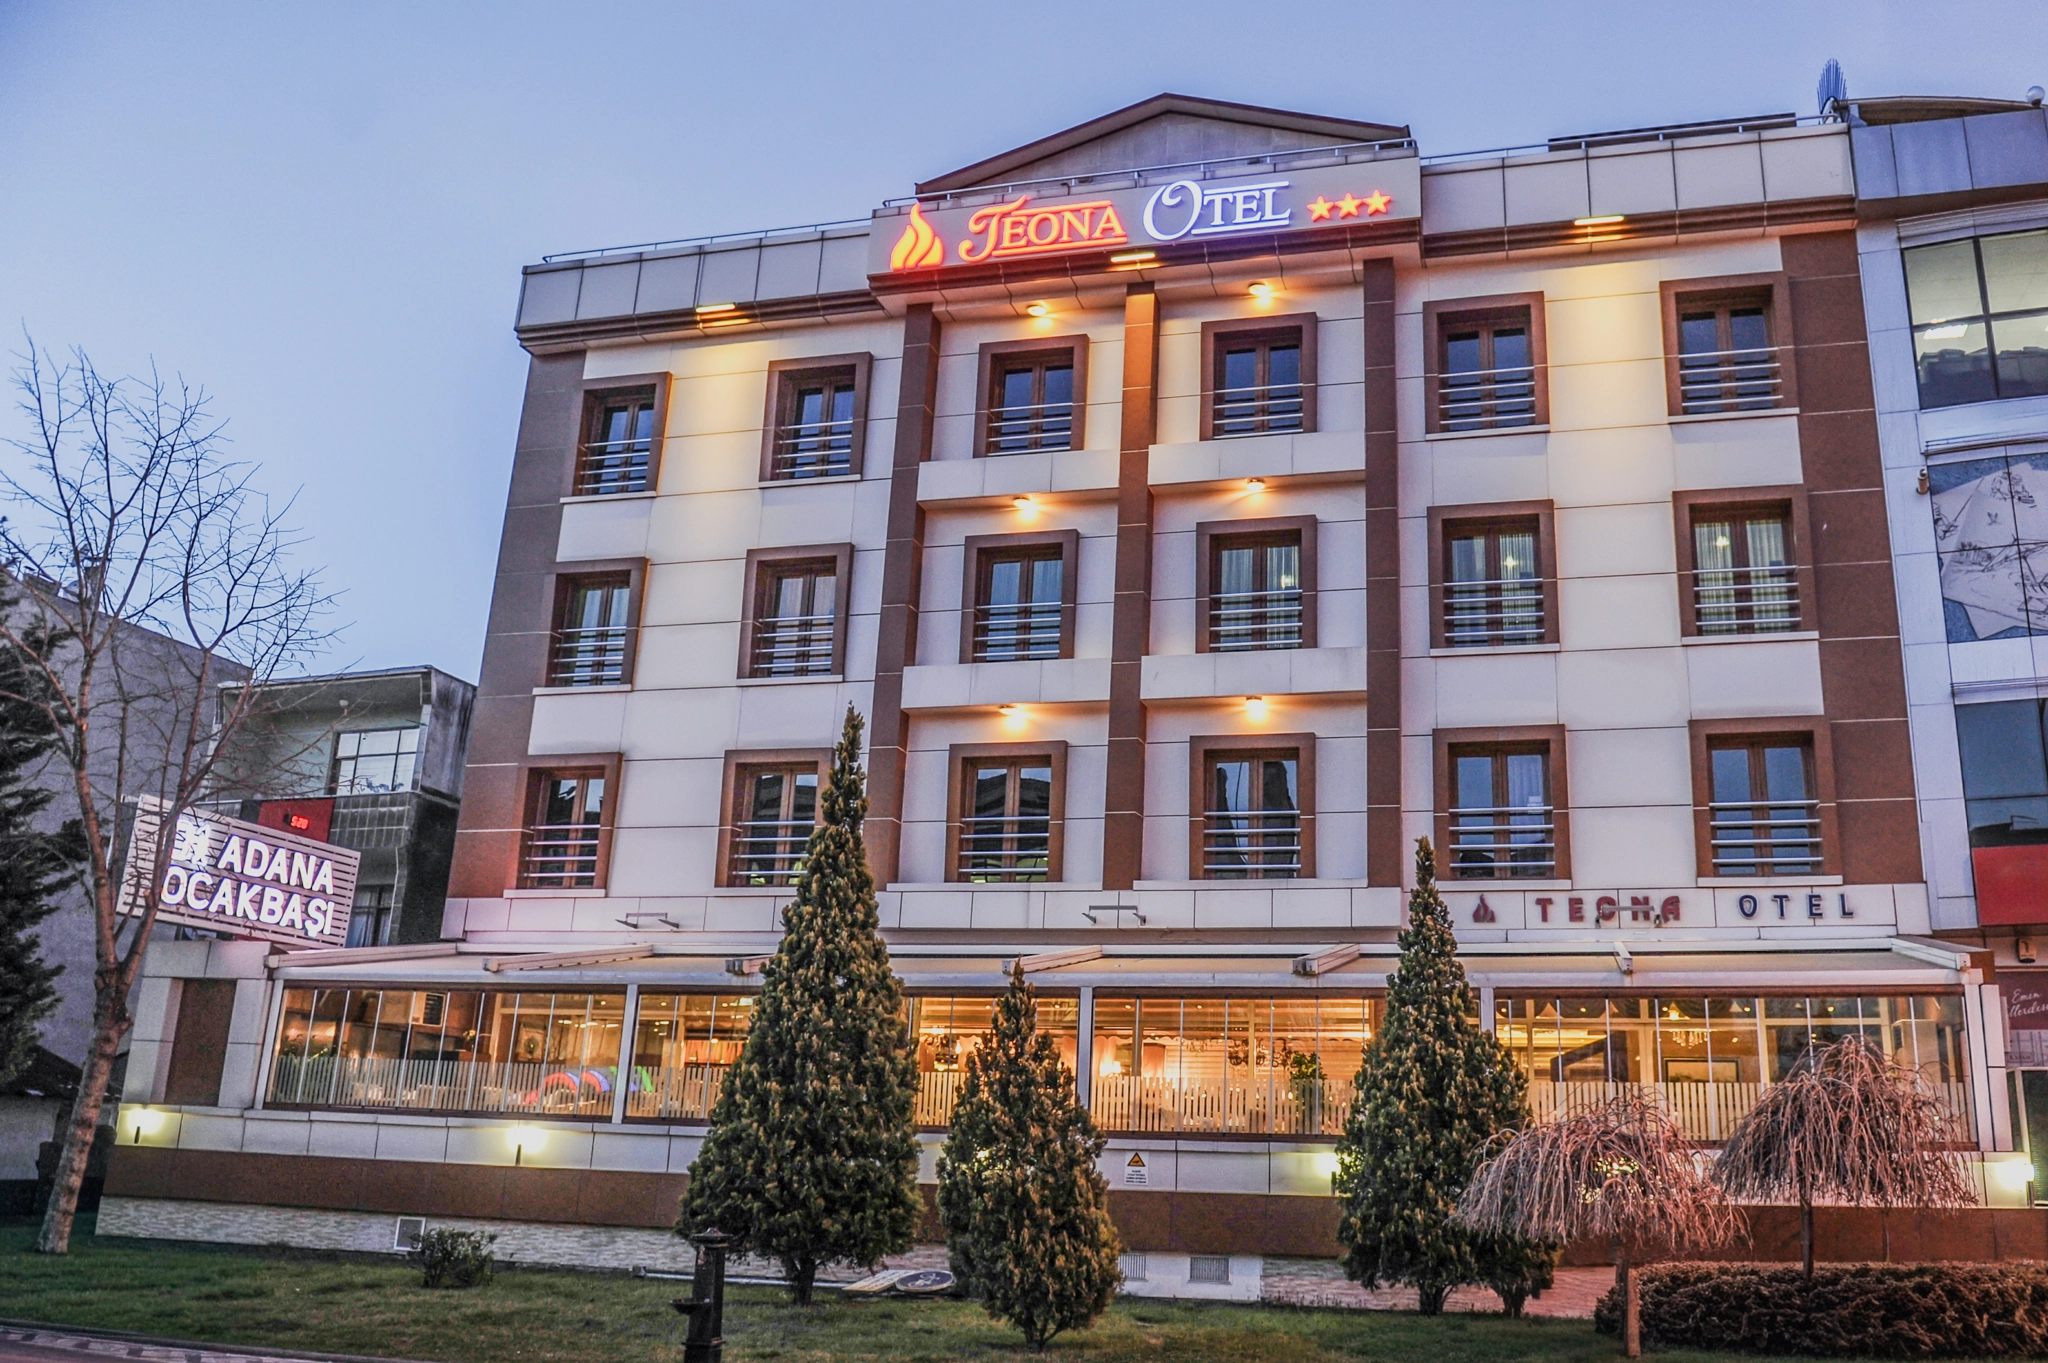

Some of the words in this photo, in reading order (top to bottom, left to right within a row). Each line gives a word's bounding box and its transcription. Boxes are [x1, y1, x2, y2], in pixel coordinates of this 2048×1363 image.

[958, 194, 1128, 263] TEONA
[1143, 180, 1291, 241] OTEL
[217, 834, 335, 895] ADANA
[161, 865, 335, 938] OCAKBAŞI
[1535, 895, 1680, 924] TEONA
[1737, 893, 1854, 920] OTEL
